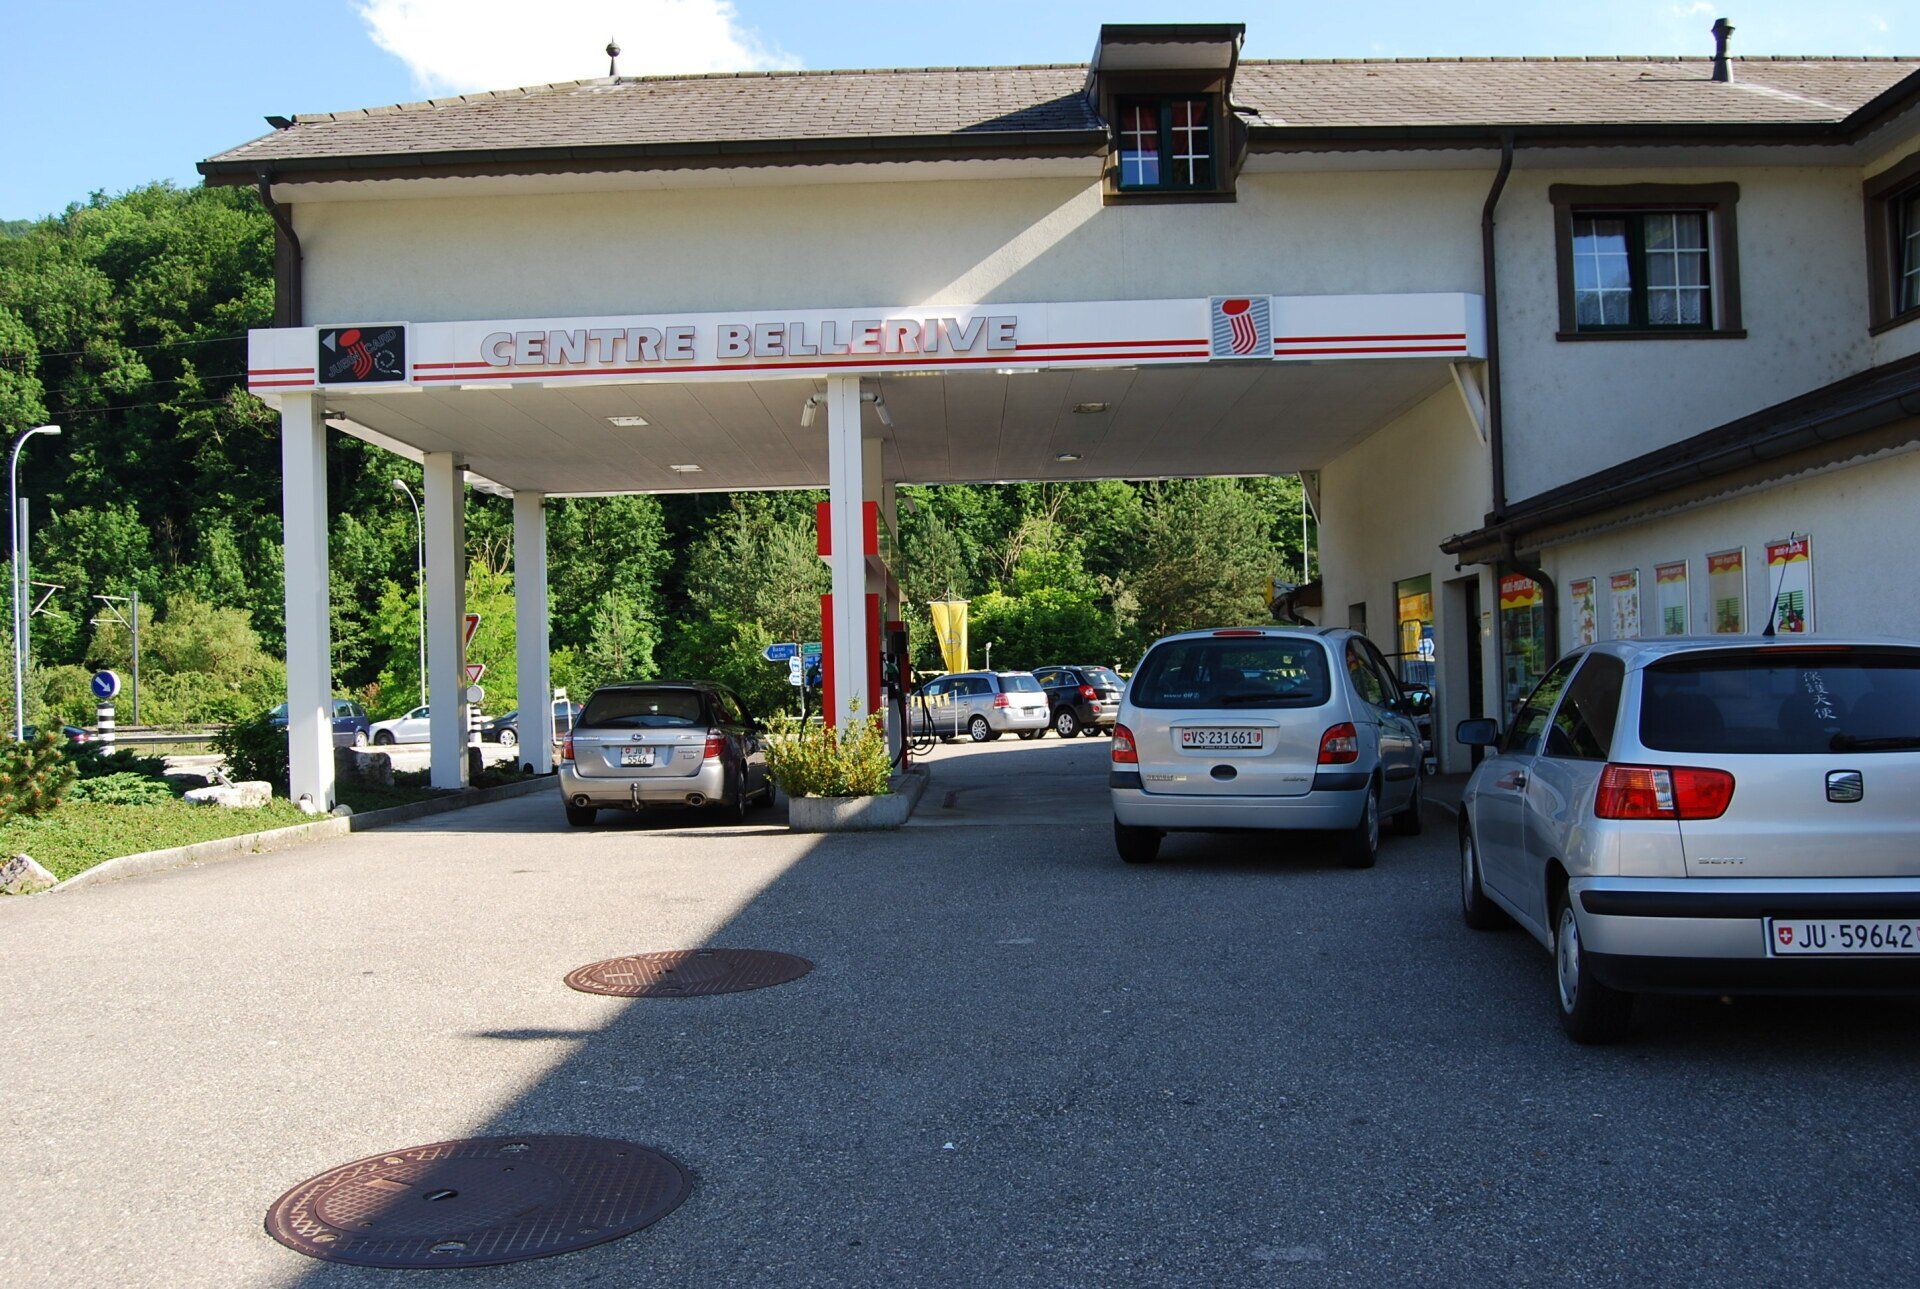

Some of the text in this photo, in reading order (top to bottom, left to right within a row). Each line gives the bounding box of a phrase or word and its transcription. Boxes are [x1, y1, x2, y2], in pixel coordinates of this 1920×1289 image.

[364, 329, 396, 355] CARD
[480, 315, 1018, 367] CENTRE BELLERIVE
[627, 755, 647, 764] 5546
